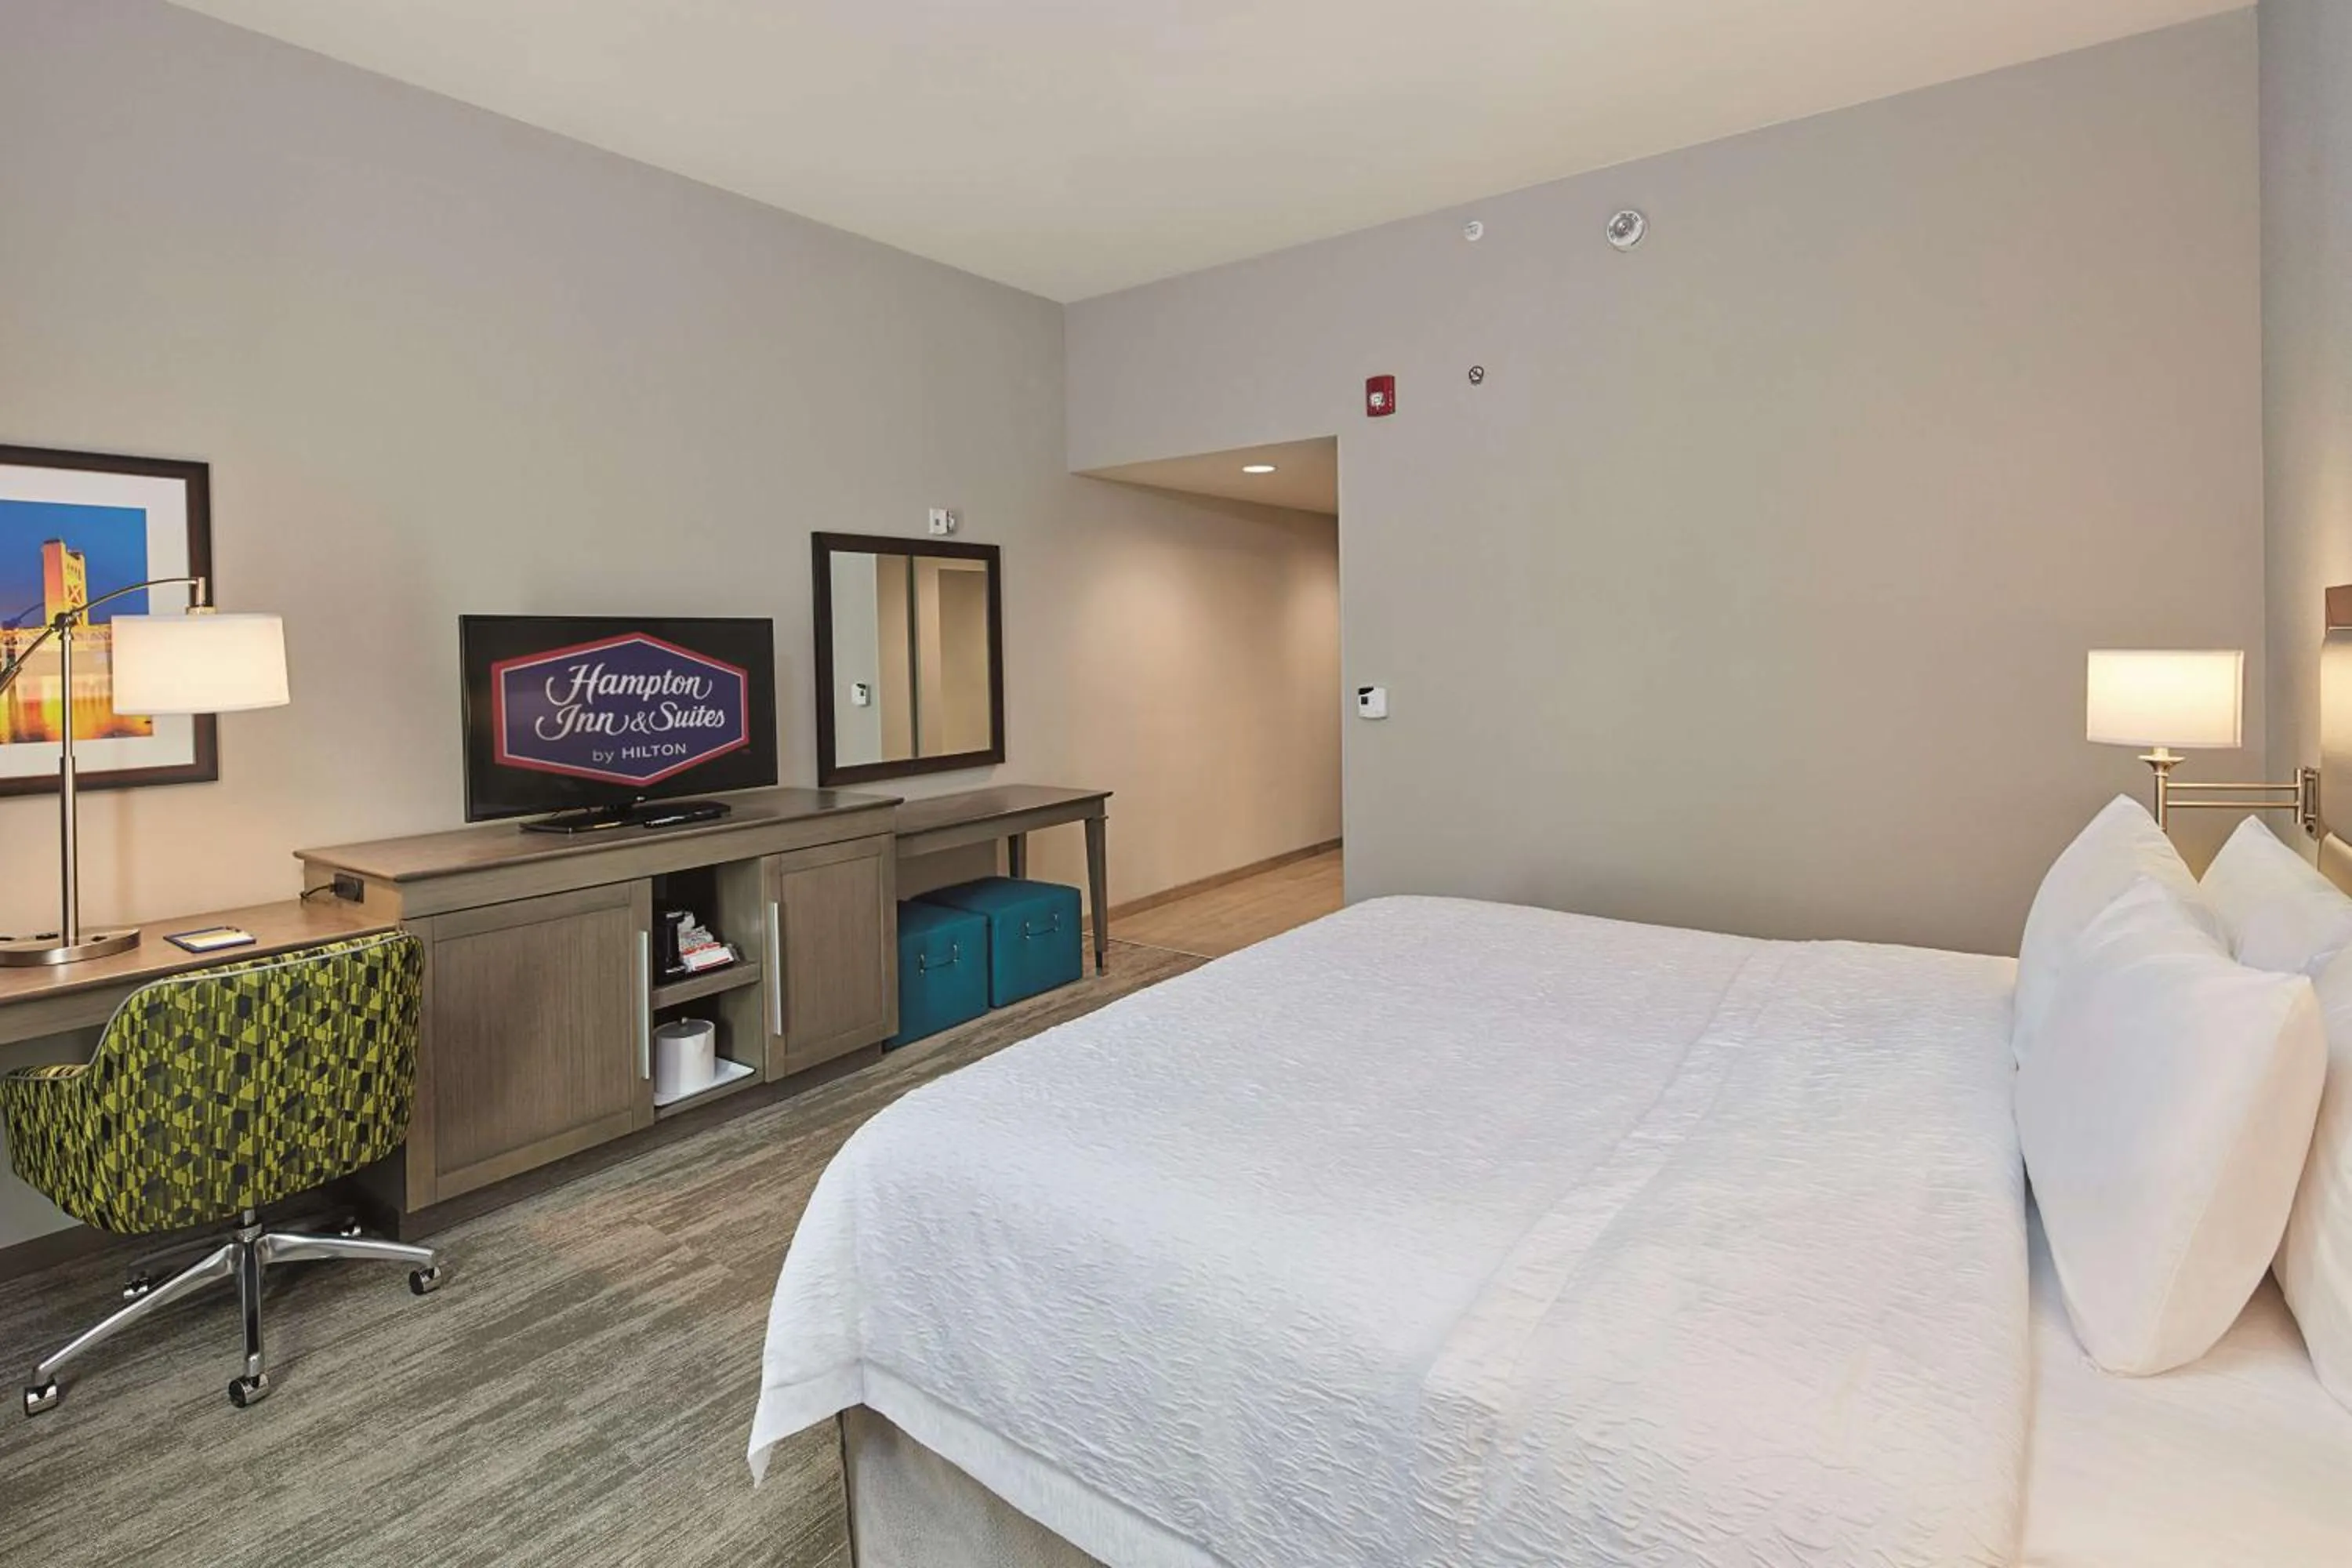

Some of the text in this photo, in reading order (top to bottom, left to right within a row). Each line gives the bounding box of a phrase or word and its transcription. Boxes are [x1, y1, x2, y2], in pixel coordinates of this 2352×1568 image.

[546, 662, 713, 706] Hampton
[535, 702, 726, 741] Inn & Suites
[592, 742, 687, 764] by HILTON
